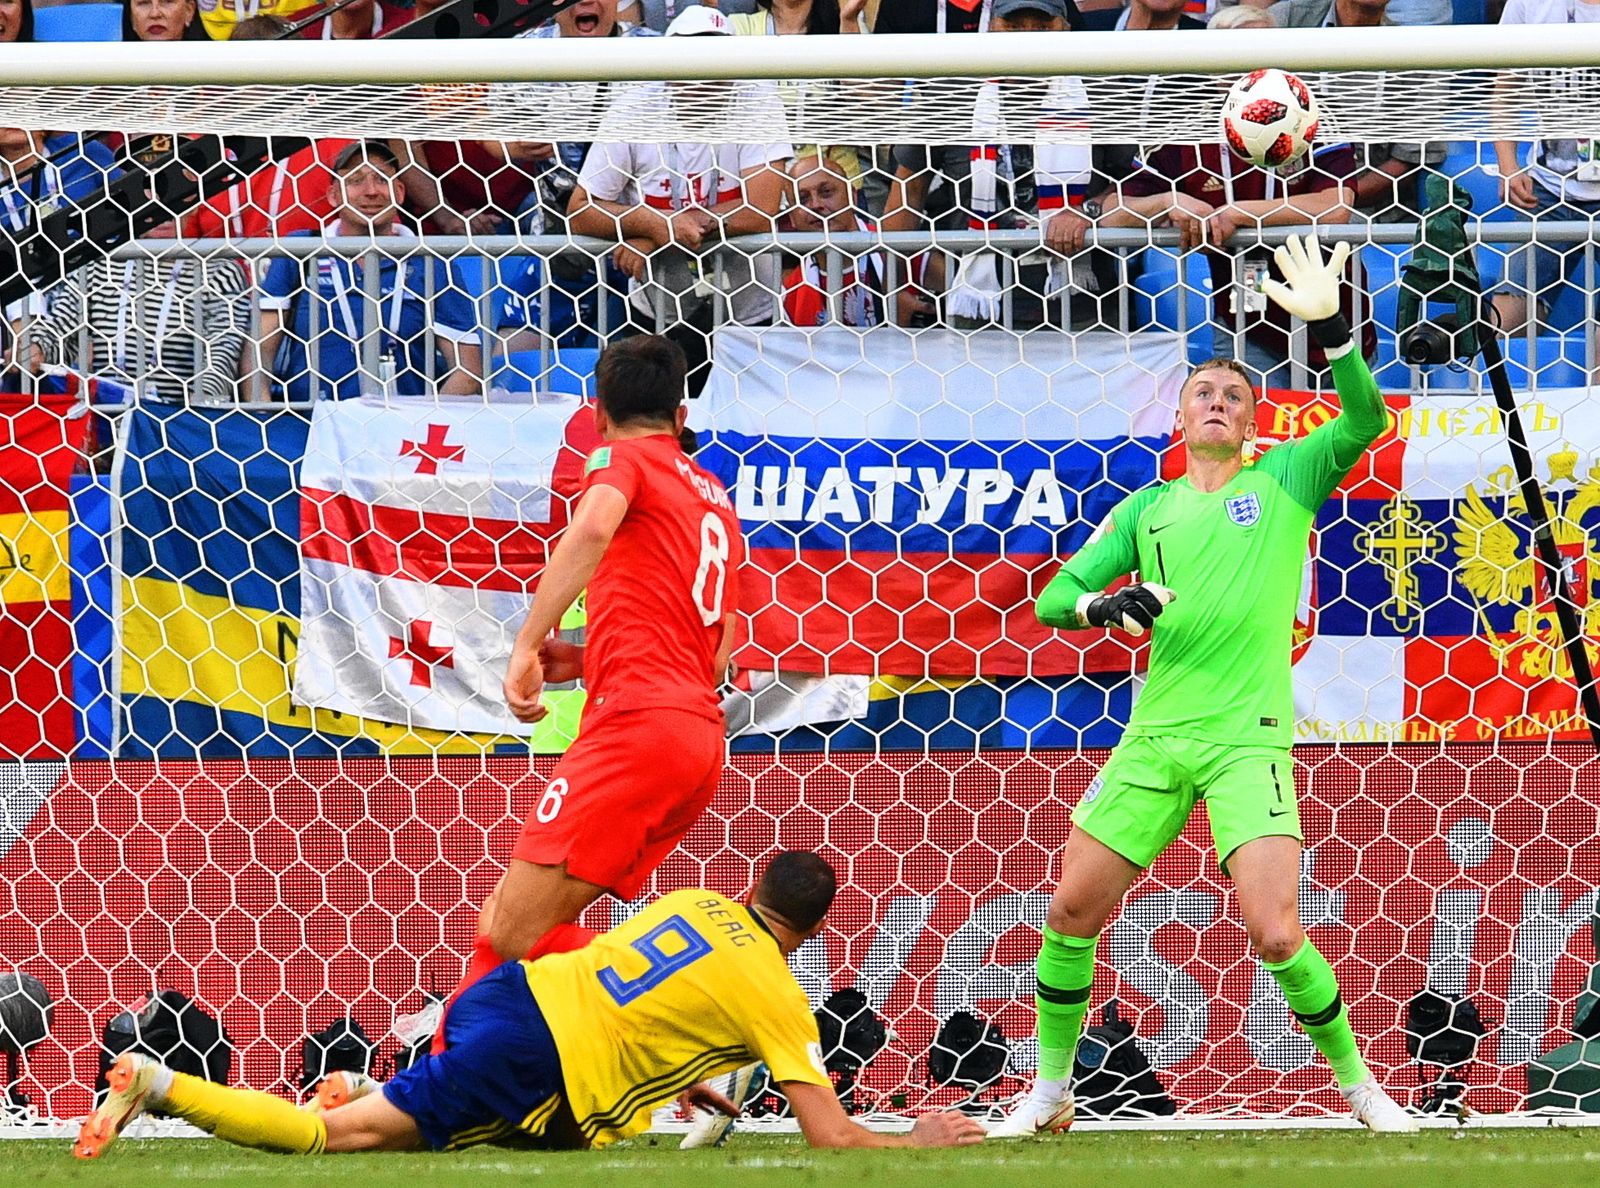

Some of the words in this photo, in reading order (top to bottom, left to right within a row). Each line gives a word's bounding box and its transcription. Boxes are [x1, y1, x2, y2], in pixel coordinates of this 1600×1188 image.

[736, 464, 1069, 526] ШАТУРА
[1156, 541, 1166, 586] 1
[536, 777, 569, 823] 6
[695, 898, 758, 947] BERG
[596, 914, 714, 1008] 9
